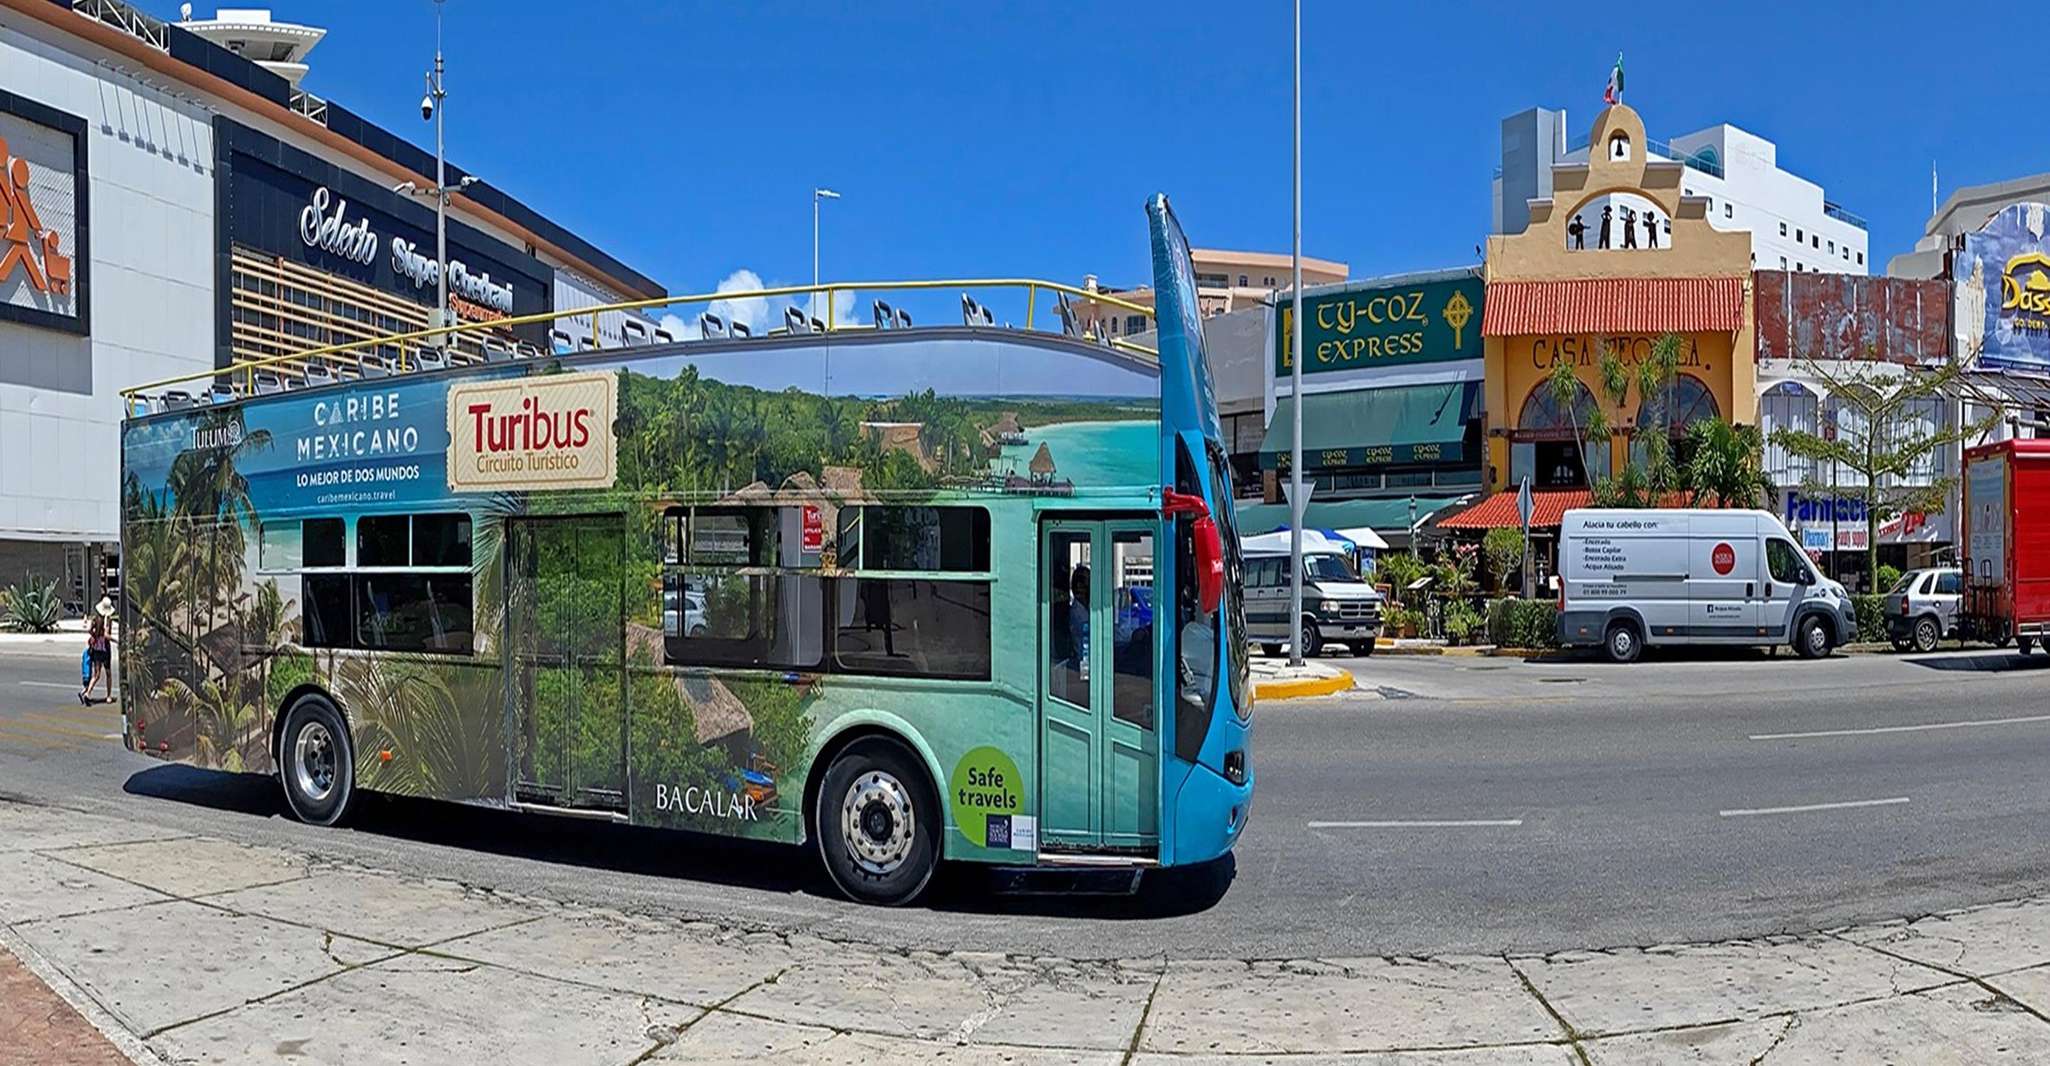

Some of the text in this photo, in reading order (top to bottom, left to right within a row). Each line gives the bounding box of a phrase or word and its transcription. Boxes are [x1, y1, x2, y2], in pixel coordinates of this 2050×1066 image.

[300, 186, 378, 266] Selecto
[391, 236, 448, 290] Súpe
[1316, 291, 1425, 334] TY-COZ
[1316, 332, 1424, 364] EXPRESS
[1532, 337, 1591, 369] CASA
[314, 393, 400, 426] CARIBE
[468, 396, 589, 453] Turibus
[297, 427, 418, 461] MEXICANO
[297, 465, 420, 487] LO MEJOR DE DOS MUNDOS
[476, 450, 579, 473] Circuito Turístico
[1837, 530, 1851, 548] eauty
[968, 767, 1004, 788] Safe
[656, 784, 758, 821] BACALAR
[958, 788, 1017, 808] travels
